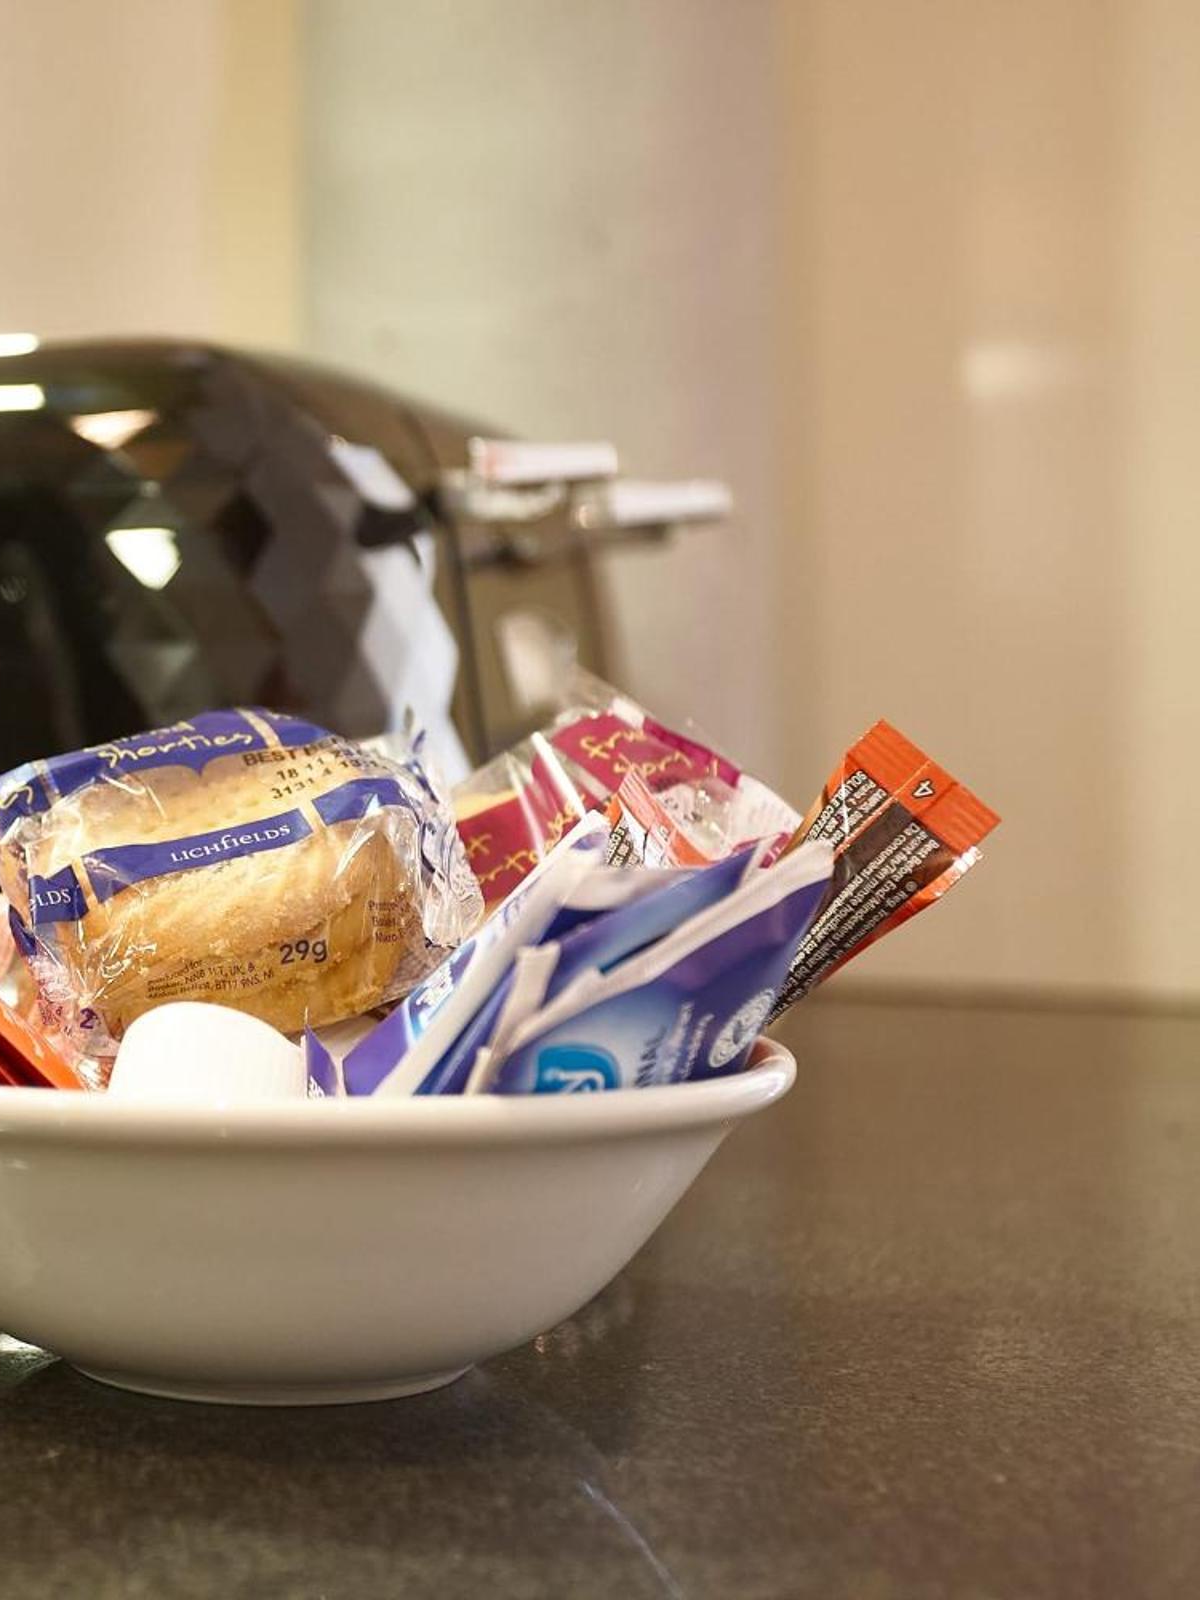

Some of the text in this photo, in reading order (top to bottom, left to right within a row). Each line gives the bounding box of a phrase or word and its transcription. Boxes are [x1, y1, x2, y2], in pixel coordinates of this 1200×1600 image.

[242, 750, 297, 767] BEST
[913, 777, 934, 799] 4
[903, 821, 919, 838] Da
[860, 833, 907, 879] consumarsi
[916, 837, 939, 860] Best
[890, 854, 922, 885] Before
[849, 877, 879, 907] minste
[279, 938, 328, 965] 29g
[803, 939, 818, 954] tot
